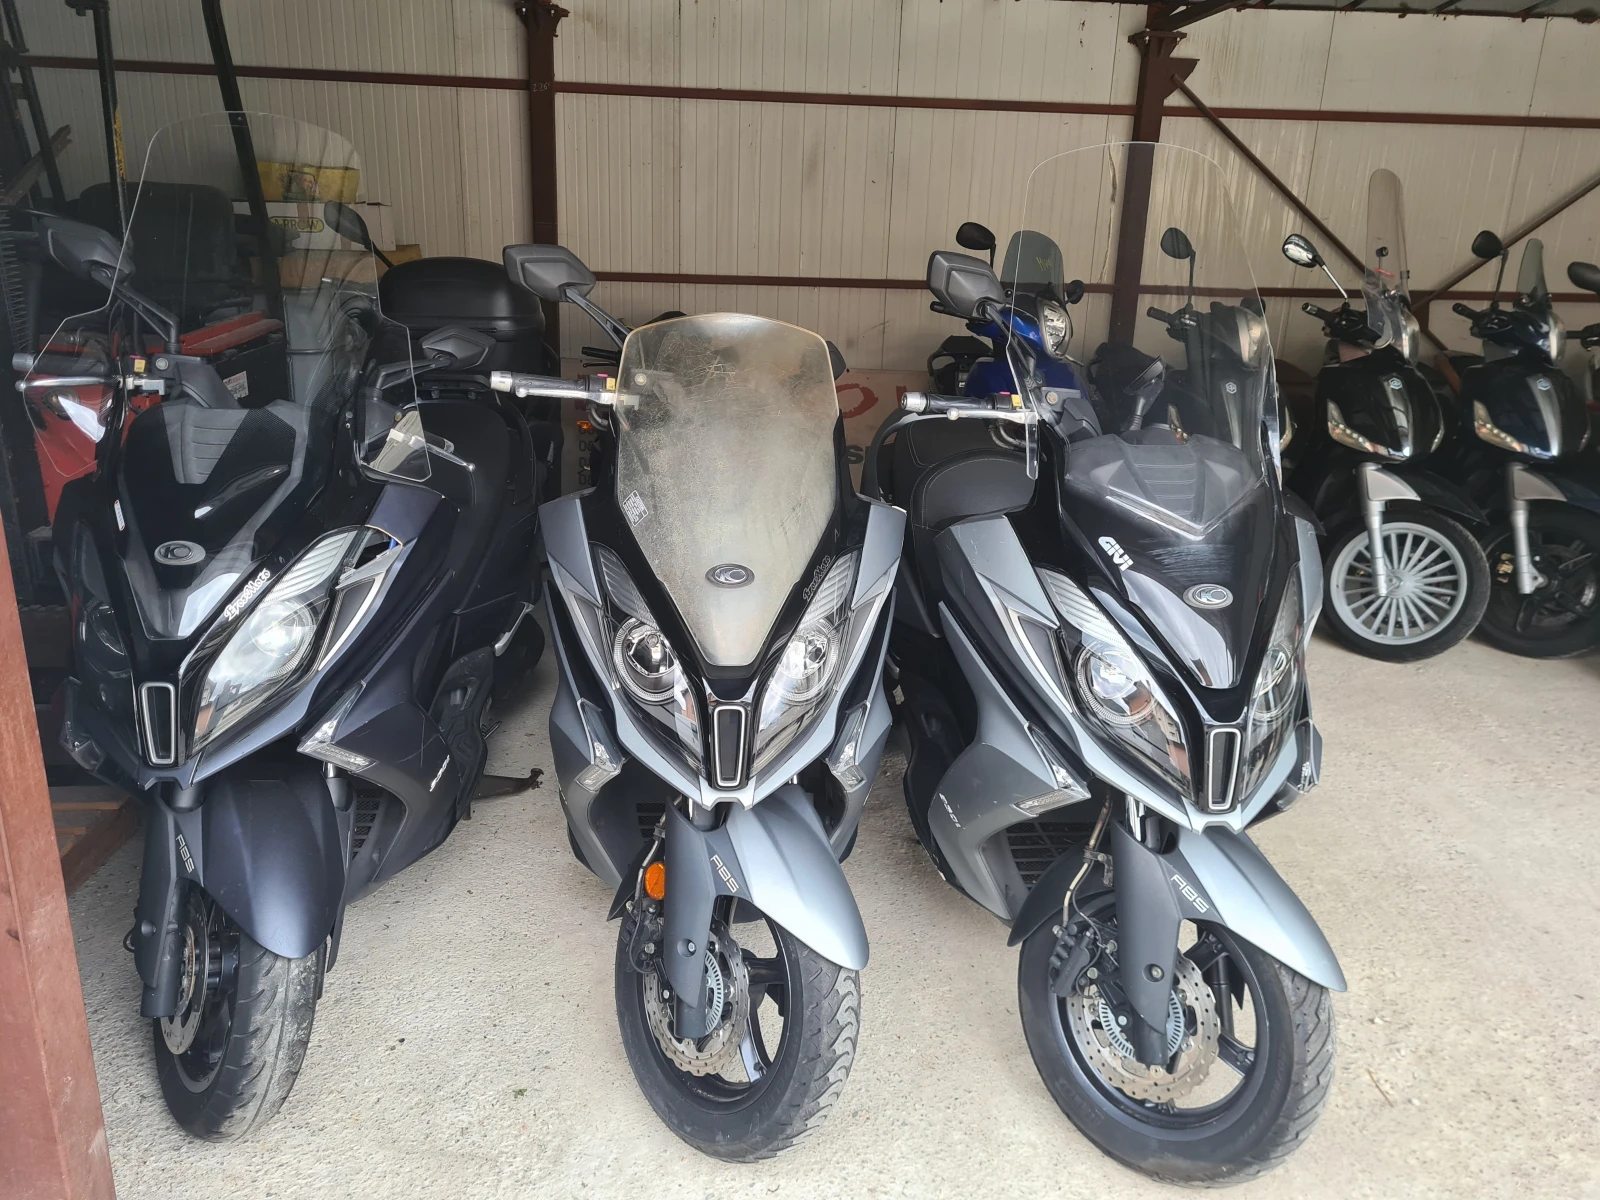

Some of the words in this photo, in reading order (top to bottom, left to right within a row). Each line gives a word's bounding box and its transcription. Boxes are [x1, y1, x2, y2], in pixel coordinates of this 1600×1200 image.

[1098, 536, 1134, 571] GIVI
[175, 833, 196, 874] ABS
[709, 854, 740, 894] ABS
[1170, 874, 1210, 914] ABS
